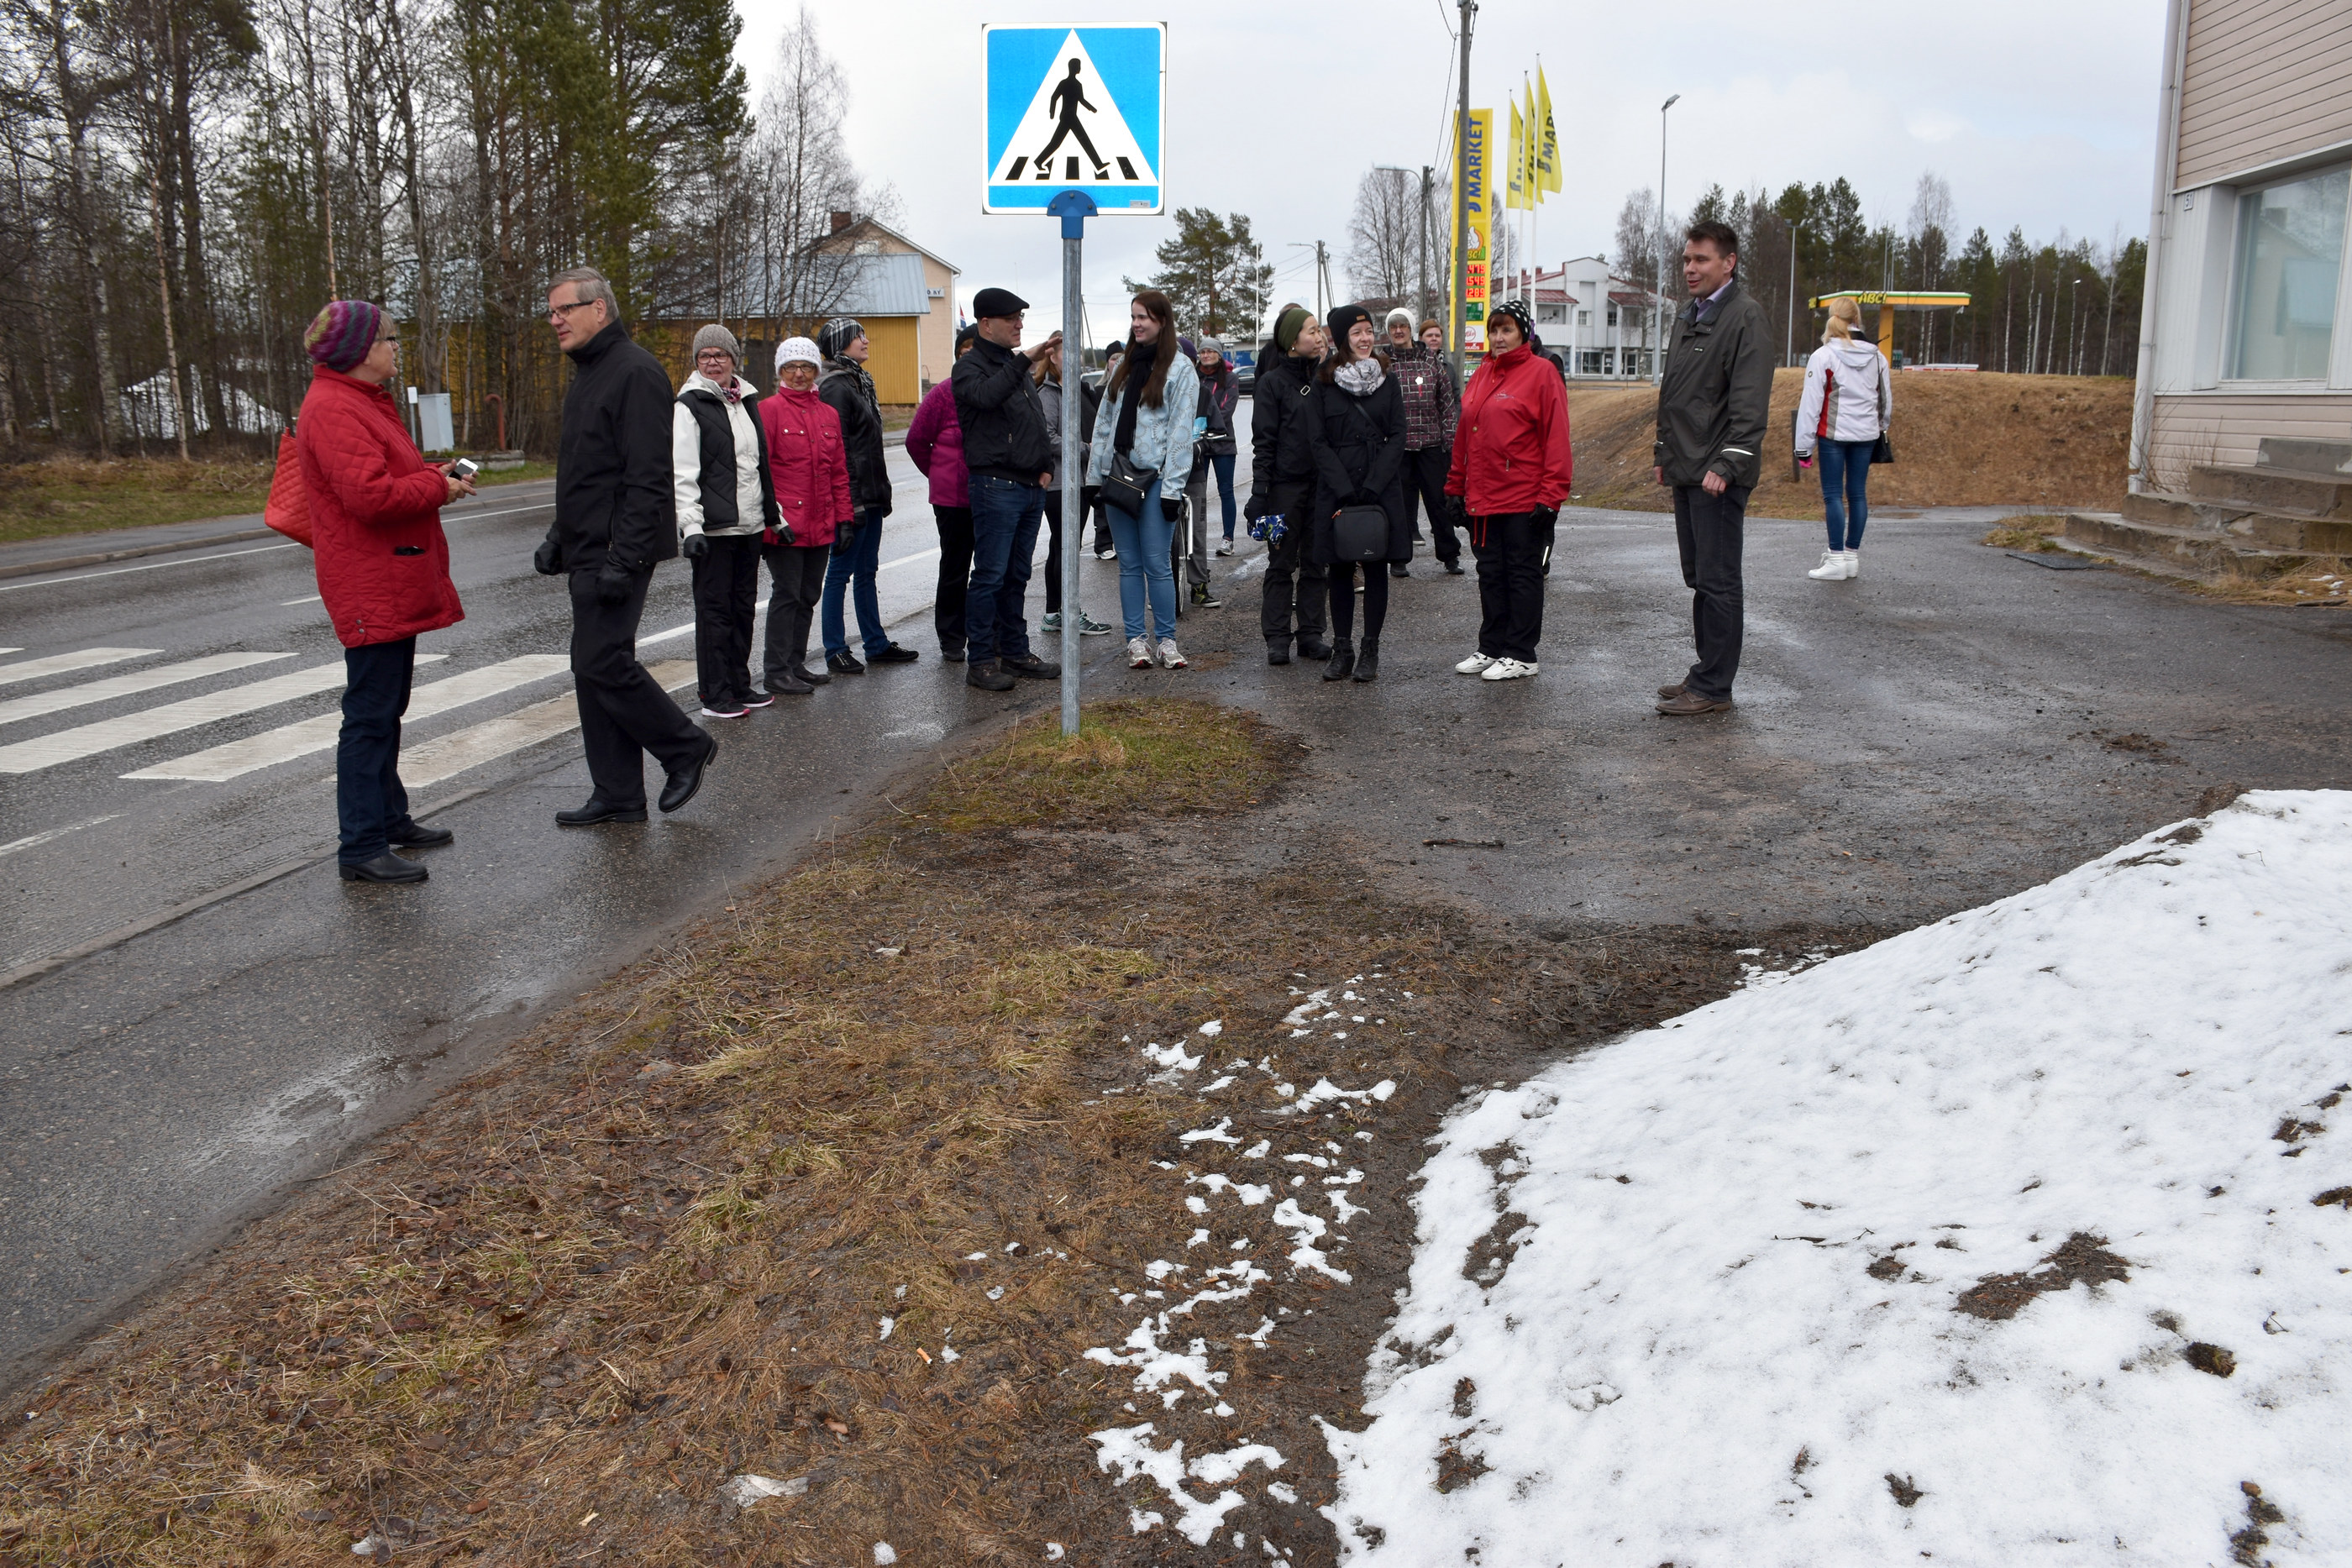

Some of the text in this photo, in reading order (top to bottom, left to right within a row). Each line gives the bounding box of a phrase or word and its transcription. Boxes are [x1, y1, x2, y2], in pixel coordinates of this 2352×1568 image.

[1468, 249, 1481, 260] BC!
[1467, 264, 1485, 274] .479
[1857, 292, 1887, 304] ABC!
